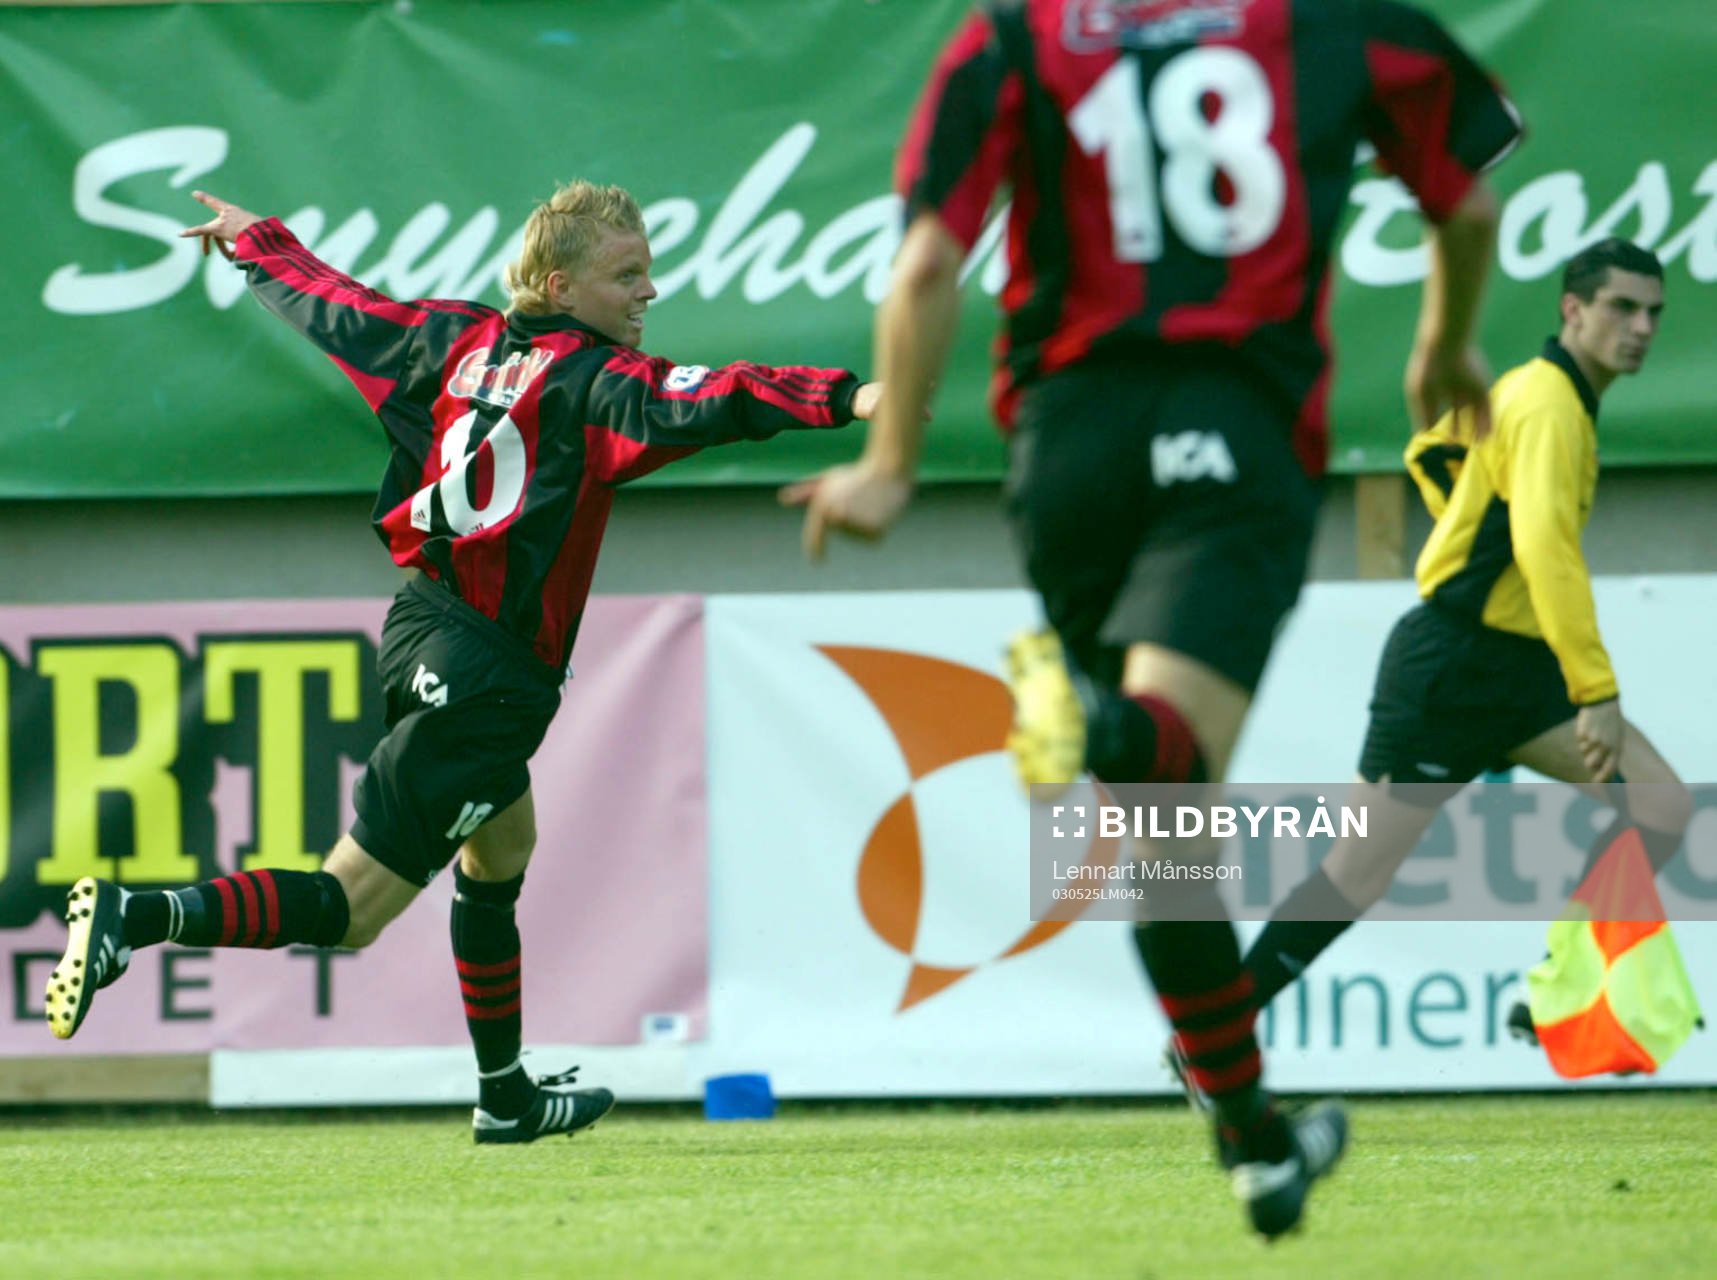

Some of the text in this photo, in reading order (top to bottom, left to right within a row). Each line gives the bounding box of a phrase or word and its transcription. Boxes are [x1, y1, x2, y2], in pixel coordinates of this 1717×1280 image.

[1067, 46, 1287, 263] 18
[1150, 431, 1238, 487] ICA
[0, 638, 361, 885] RT
